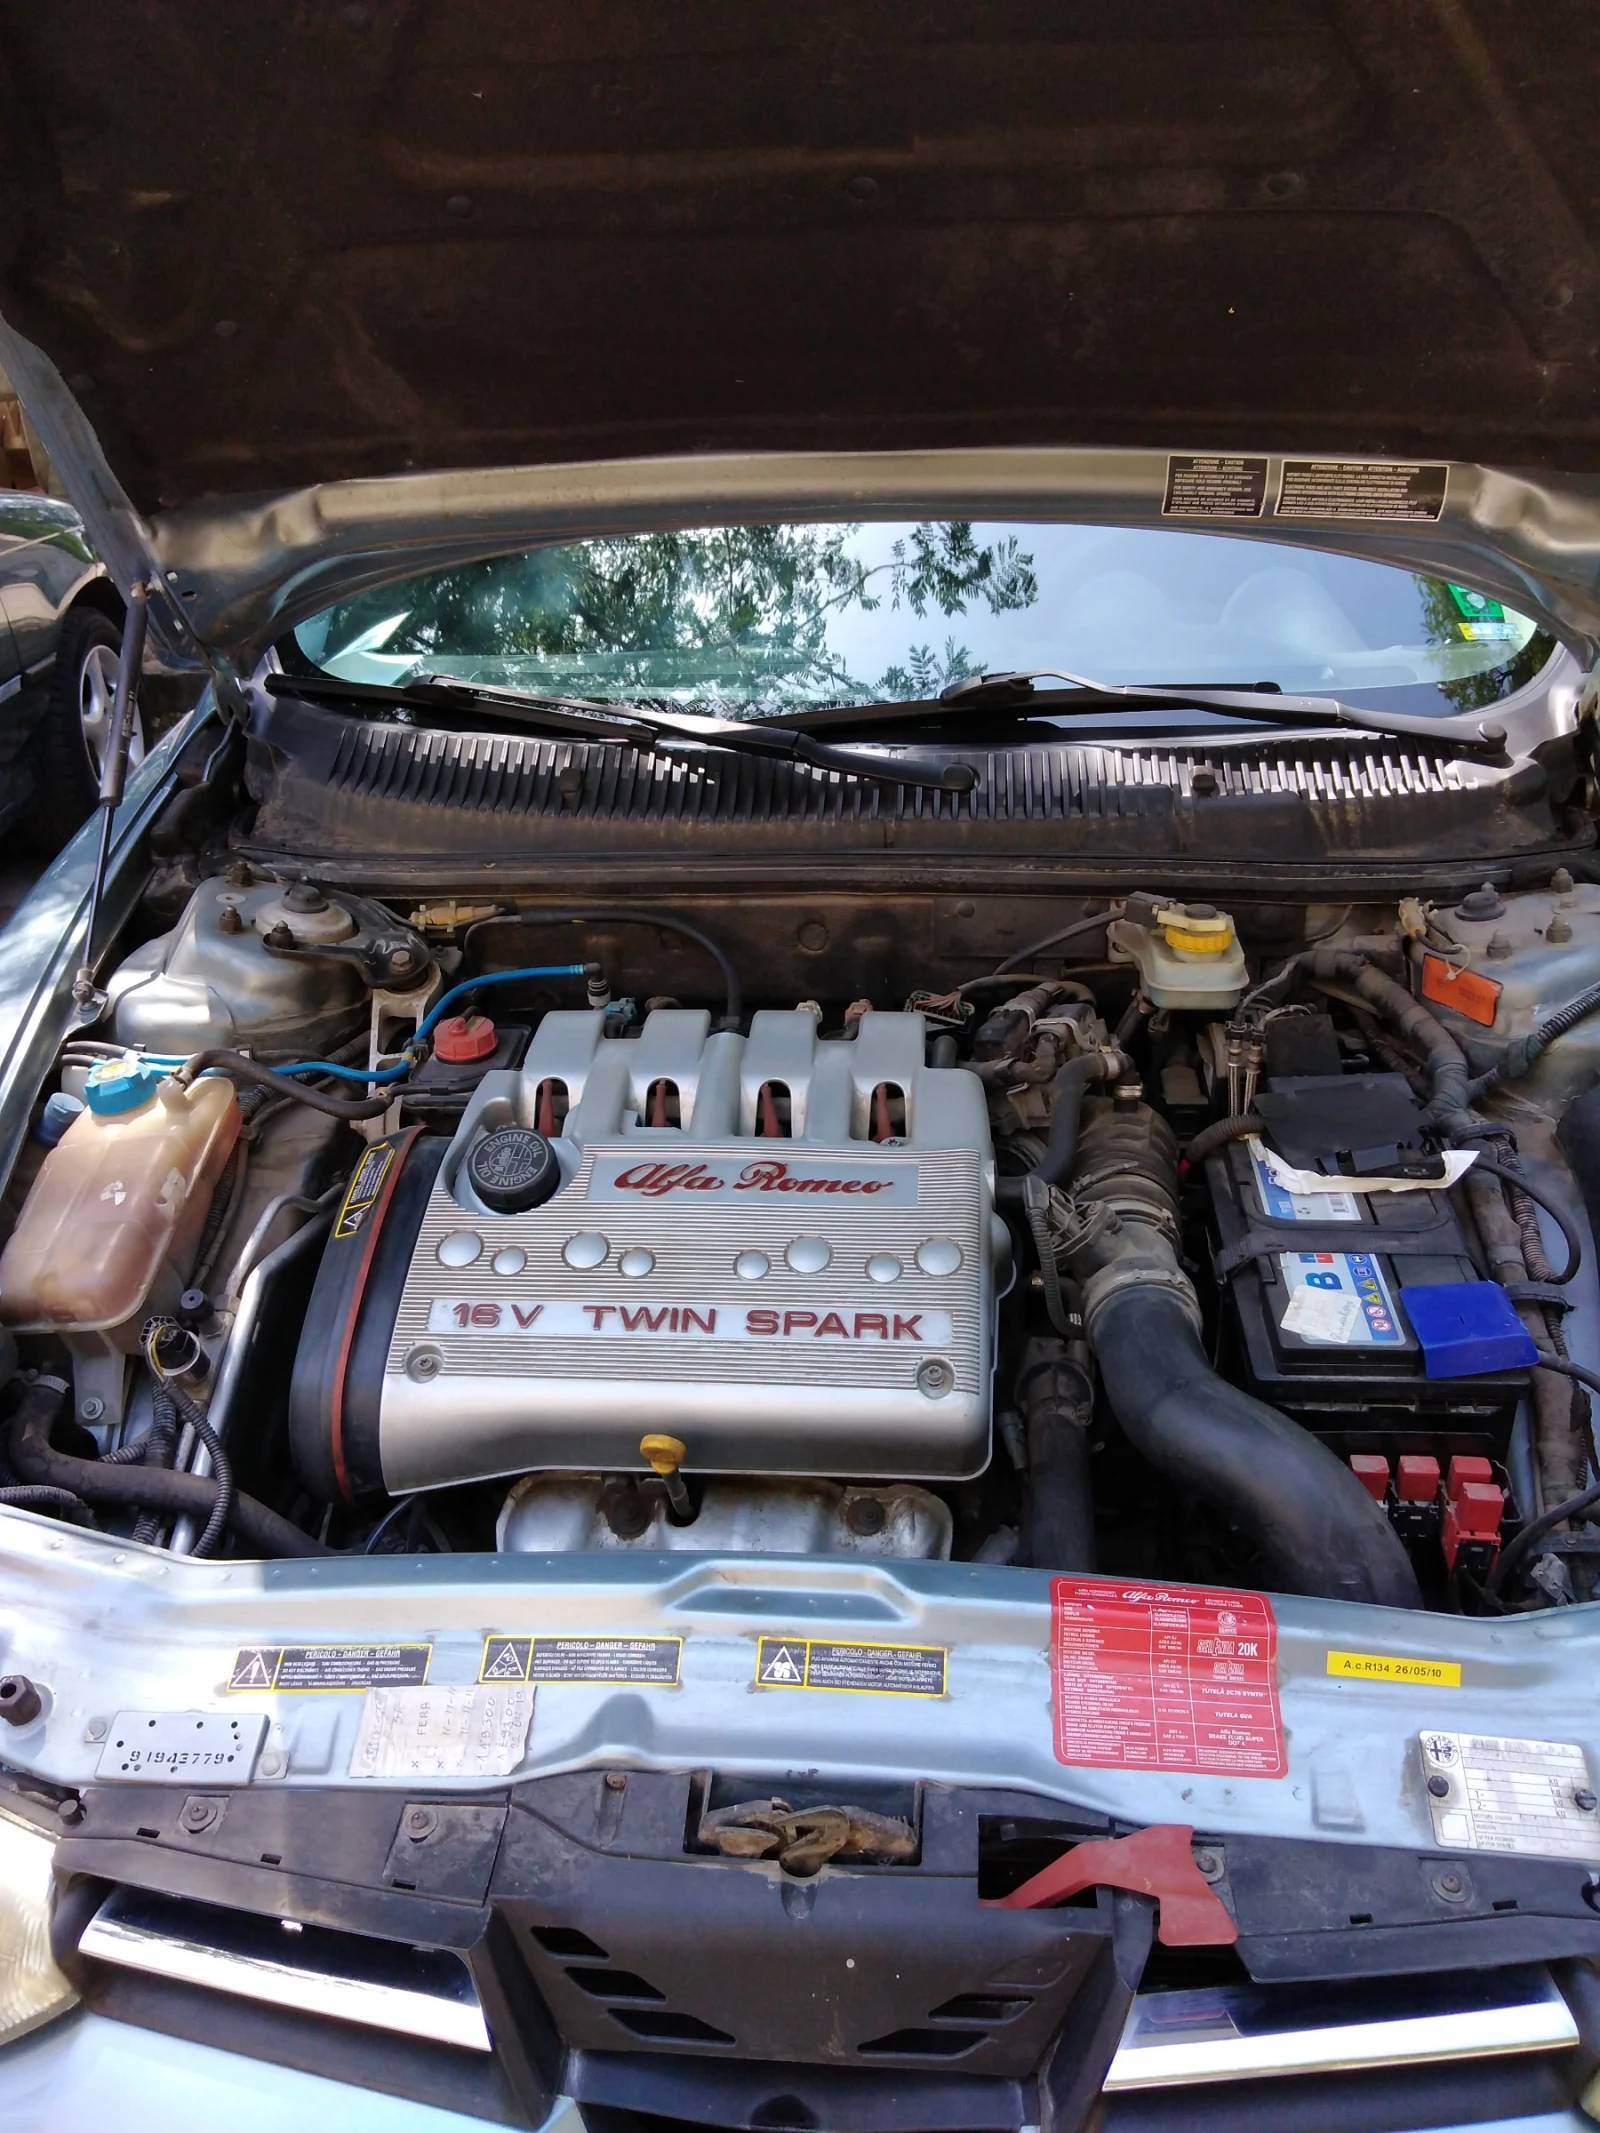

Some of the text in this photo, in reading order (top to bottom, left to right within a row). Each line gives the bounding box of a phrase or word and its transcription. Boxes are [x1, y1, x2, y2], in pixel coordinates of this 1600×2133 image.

[484, 1134, 543, 1158] ENGINE OIL
[478, 1161, 537, 1185] ENGINE OIL
[614, 1160, 893, 1196] Alfa Romeo
[583, 1305, 716, 1333] TWIN
[746, 1309, 923, 1341] SPARK
[1122, 1591, 1154, 1602] Alfa
[1155, 1593, 1199, 1604] Romeo
[630, 1642, 655, 1651] GEFAHR
[832, 1647, 921, 1660] PERICOLO DANGER GEFAHR
[1238, 1642, 1258, 1656] 20K
[305, 1651, 336, 1659] PERICOLO
[376, 1650, 400, 1658] GEFAHR
[1395, 1665, 1441, 1678] 26/05/10
[417, 1701, 431, 1736] FERA
